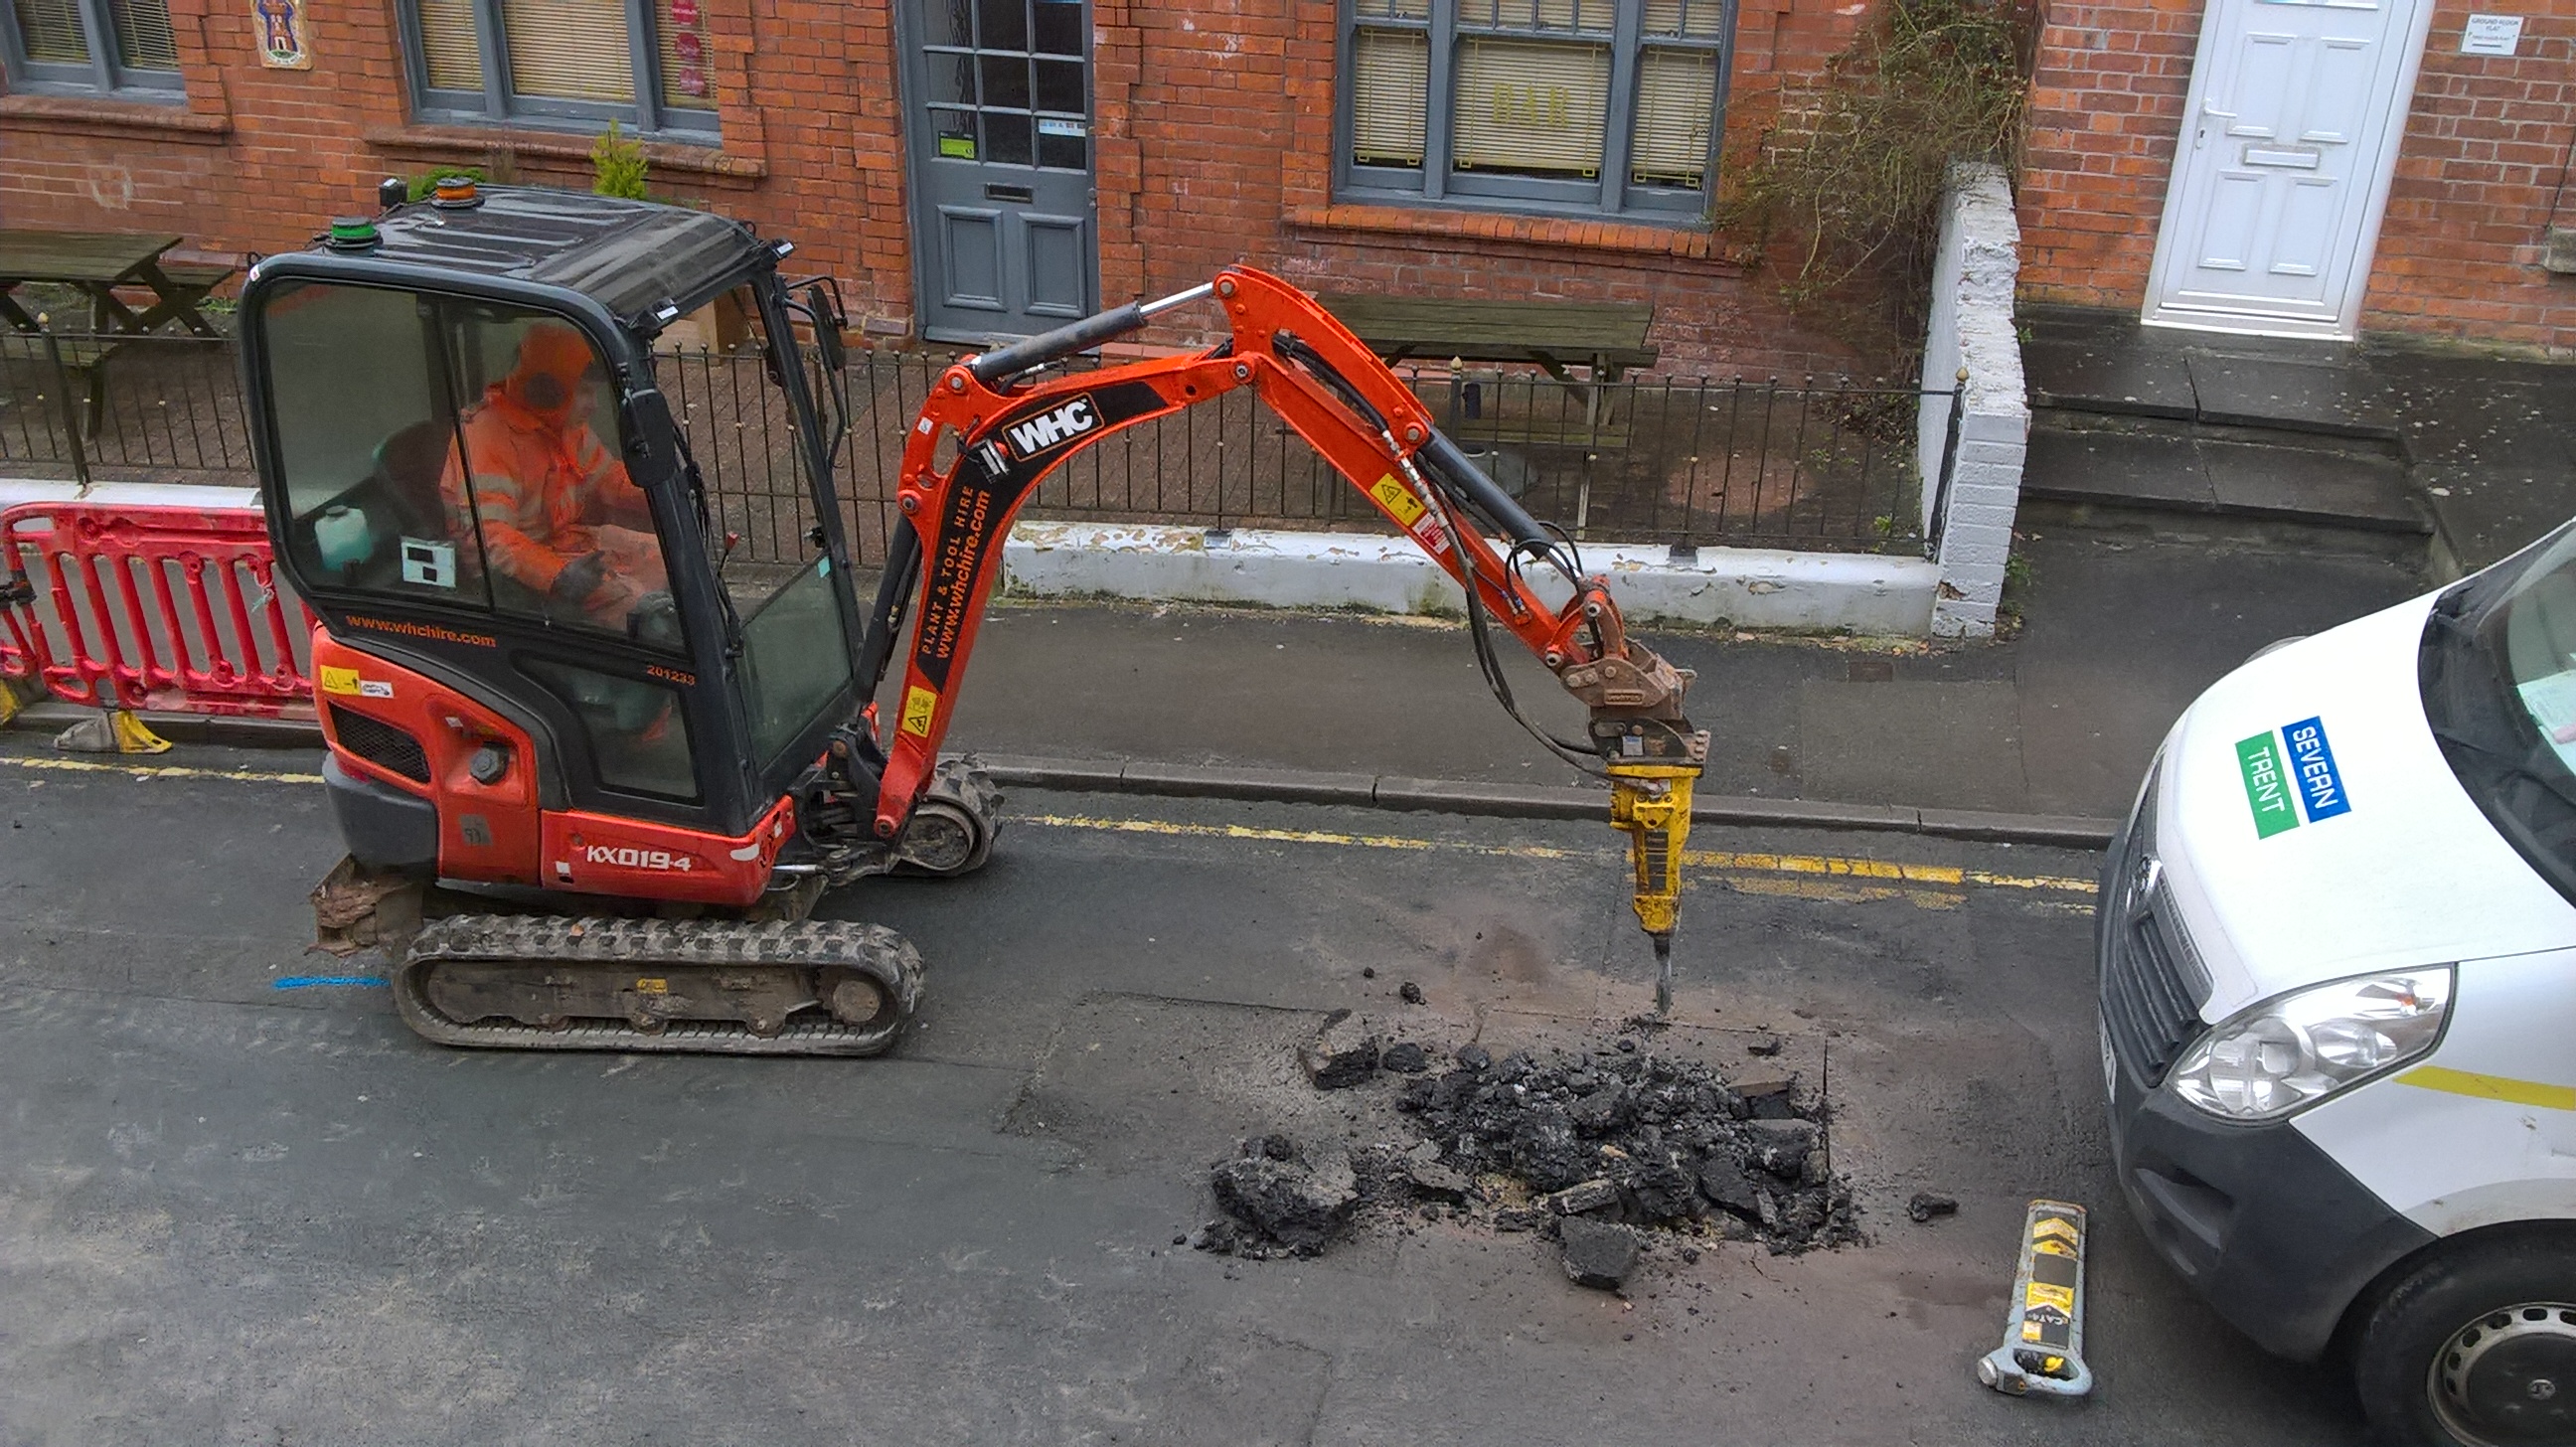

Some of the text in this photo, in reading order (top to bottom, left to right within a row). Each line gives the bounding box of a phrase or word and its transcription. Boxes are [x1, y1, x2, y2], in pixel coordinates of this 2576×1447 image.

[1493, 83, 1570, 128] BAR
[1010, 401, 1093, 454] WHC
[921, 600, 943, 655] PLANT
[941, 535, 961, 578] TOOL
[953, 485, 974, 529] HIRE
[936, 489, 991, 659] www.whchire.com
[346, 615, 496, 648] www.whchire.com
[2247, 746, 2286, 812] TRENT
[2292, 725, 2339, 810] SEVERN
